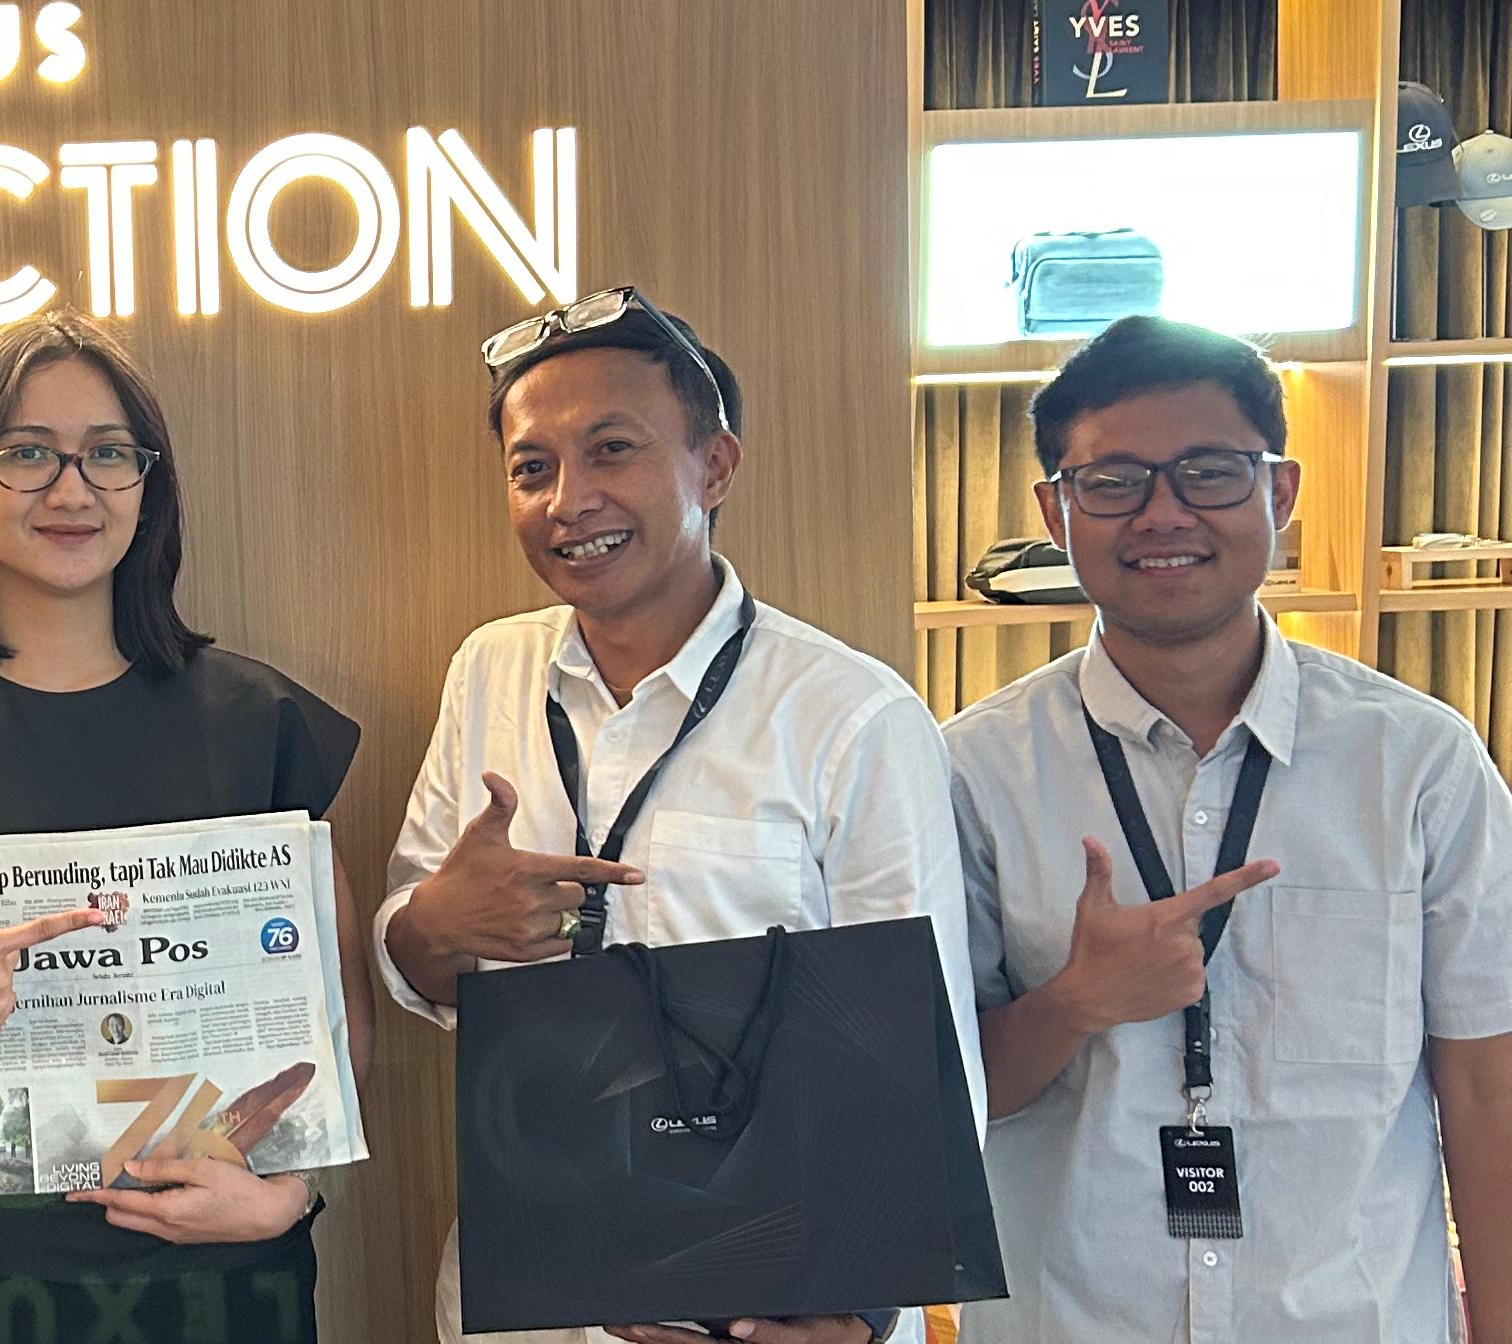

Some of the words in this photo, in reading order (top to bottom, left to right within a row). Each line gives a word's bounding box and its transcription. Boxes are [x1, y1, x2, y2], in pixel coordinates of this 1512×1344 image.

[1069, 15, 1140, 38] YVES
[13, 862, 105, 889] Berunding,
[110, 858, 143, 887] tapi
[147, 857, 176, 880] Tak
[180, 854, 208, 877] Mau
[212, 847, 267, 873] Didikte
[270, 844, 291, 867] AS
[185, 885, 210, 900] Sudah
[212, 882, 251, 897] Evakuasi
[268, 927, 293, 947] 76
[14, 946, 123, 972] Jawa
[139, 936, 209, 965] Pos
[77, 990, 157, 1006] Jurnalisme
[161, 988, 183, 1002] Era
[185, 980, 226, 1001] Digital
[53, 1161, 100, 1173] LIVING
[1175, 1167, 1224, 1179] VISITOR
[40, 1171, 100, 1184] BEYOND
[47, 1180, 101, 1192] DIGITAL
[1188, 1180, 1215, 1193] 002
